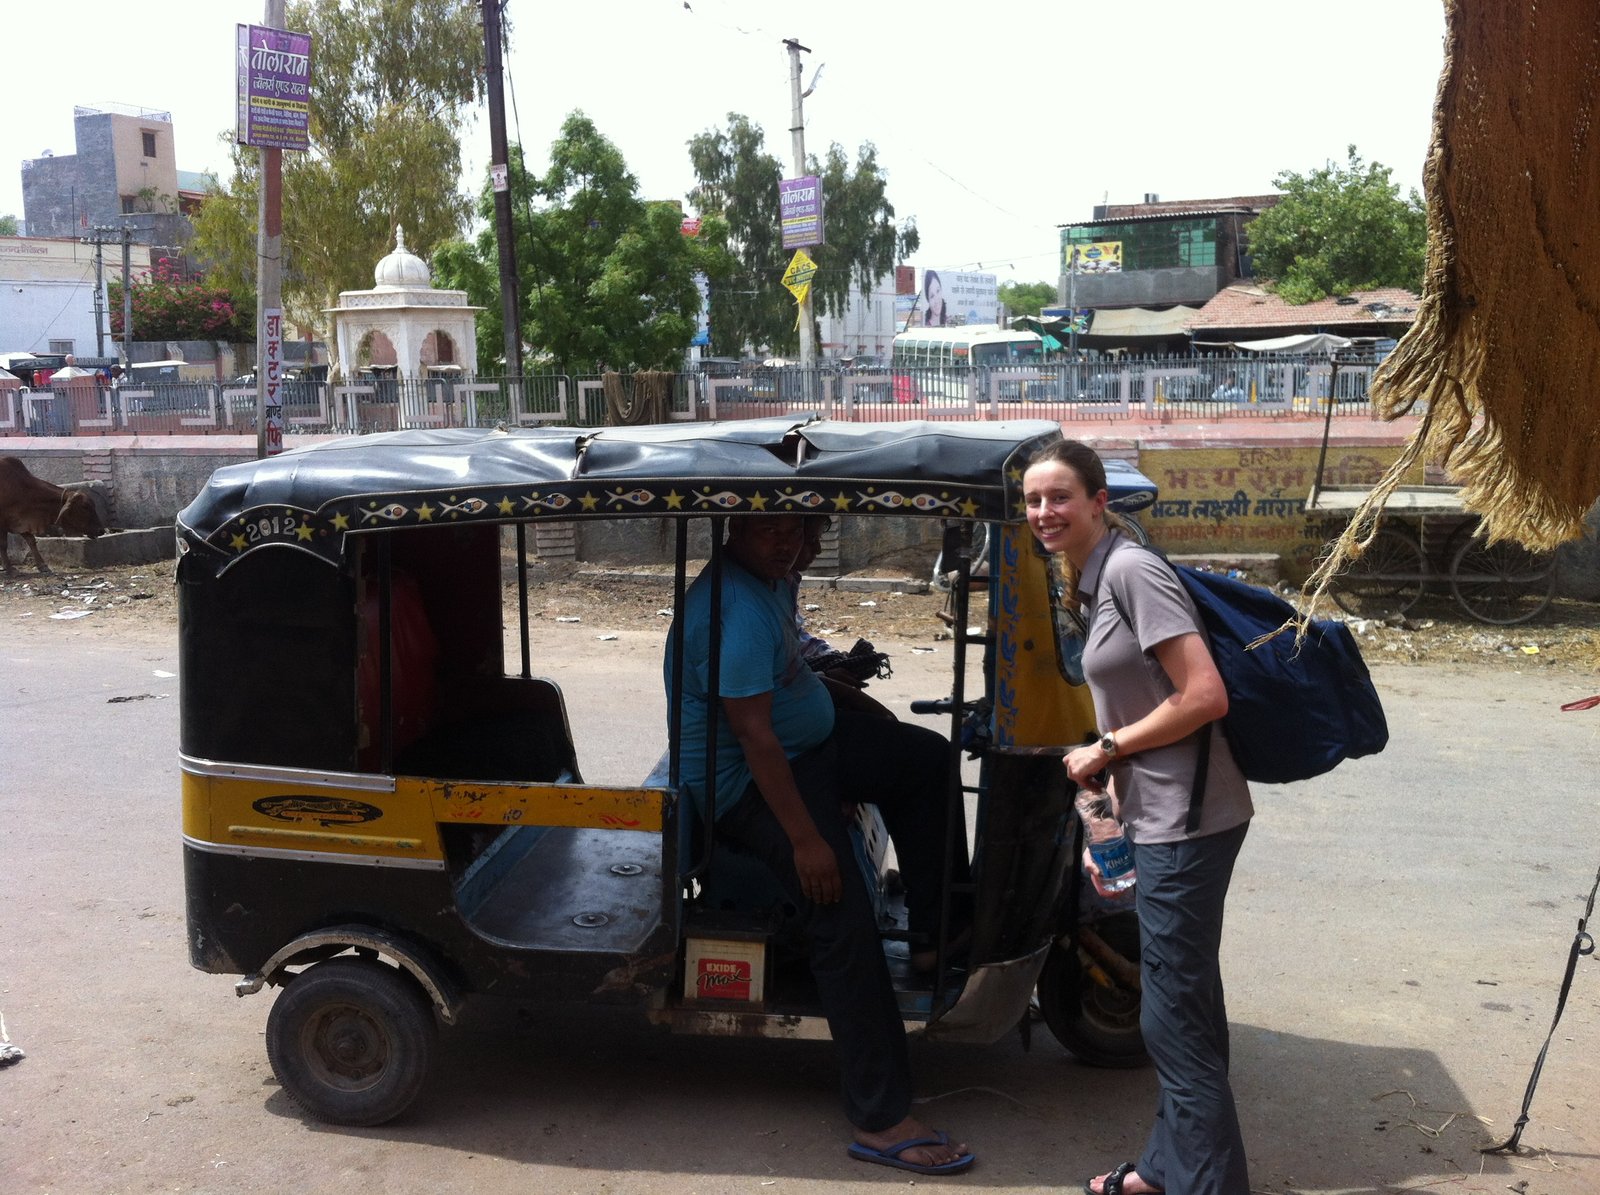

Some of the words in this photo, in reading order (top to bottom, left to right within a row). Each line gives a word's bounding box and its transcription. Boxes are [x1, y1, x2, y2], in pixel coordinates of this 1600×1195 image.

[252, 40, 308, 77] तोलाराम
[781, 186, 815, 205] तोलाराम
[246, 516, 296, 542] 2012
[706, 963, 737, 973] EXIDE
